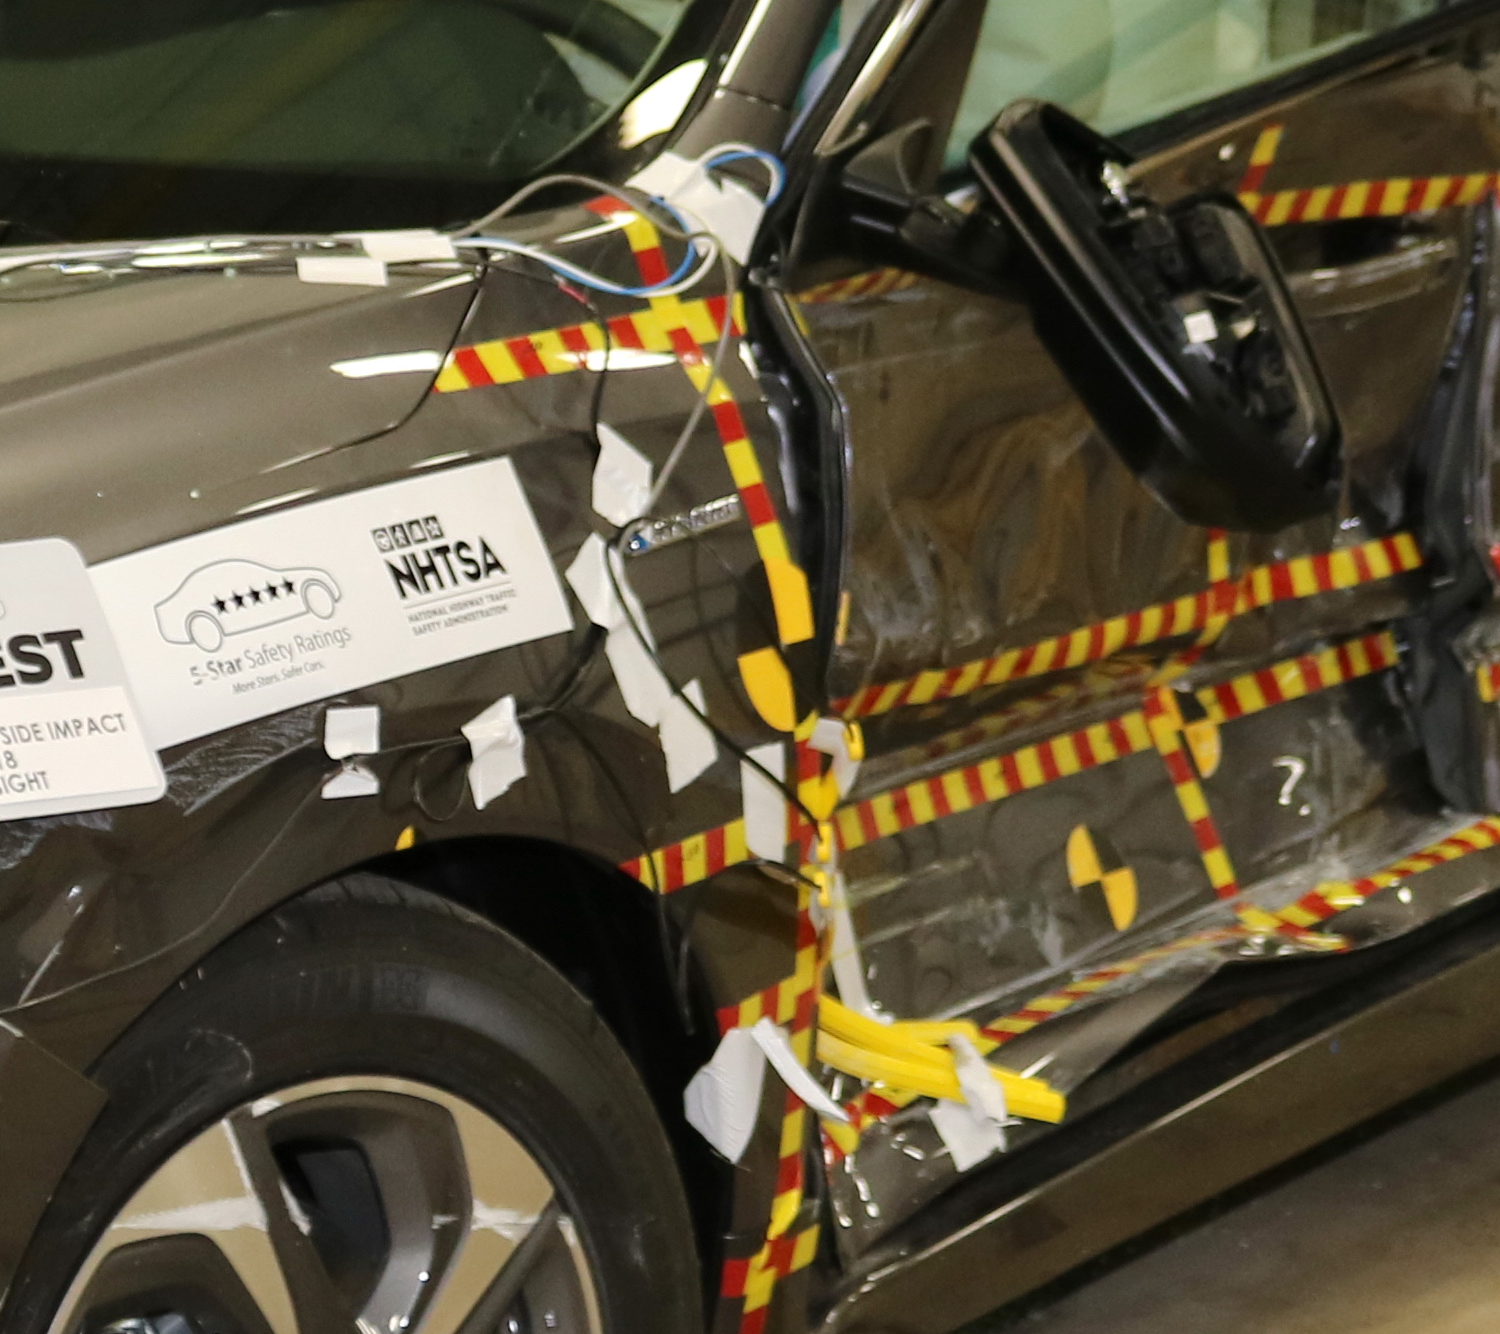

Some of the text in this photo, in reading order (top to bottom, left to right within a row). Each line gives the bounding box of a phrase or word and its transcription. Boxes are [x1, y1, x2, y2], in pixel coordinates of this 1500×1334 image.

[384, 535, 507, 599] NHTSA
[189, 627, 351, 685] 5-Star Safety Ratings
[46, 713, 126, 741] IMPACT
